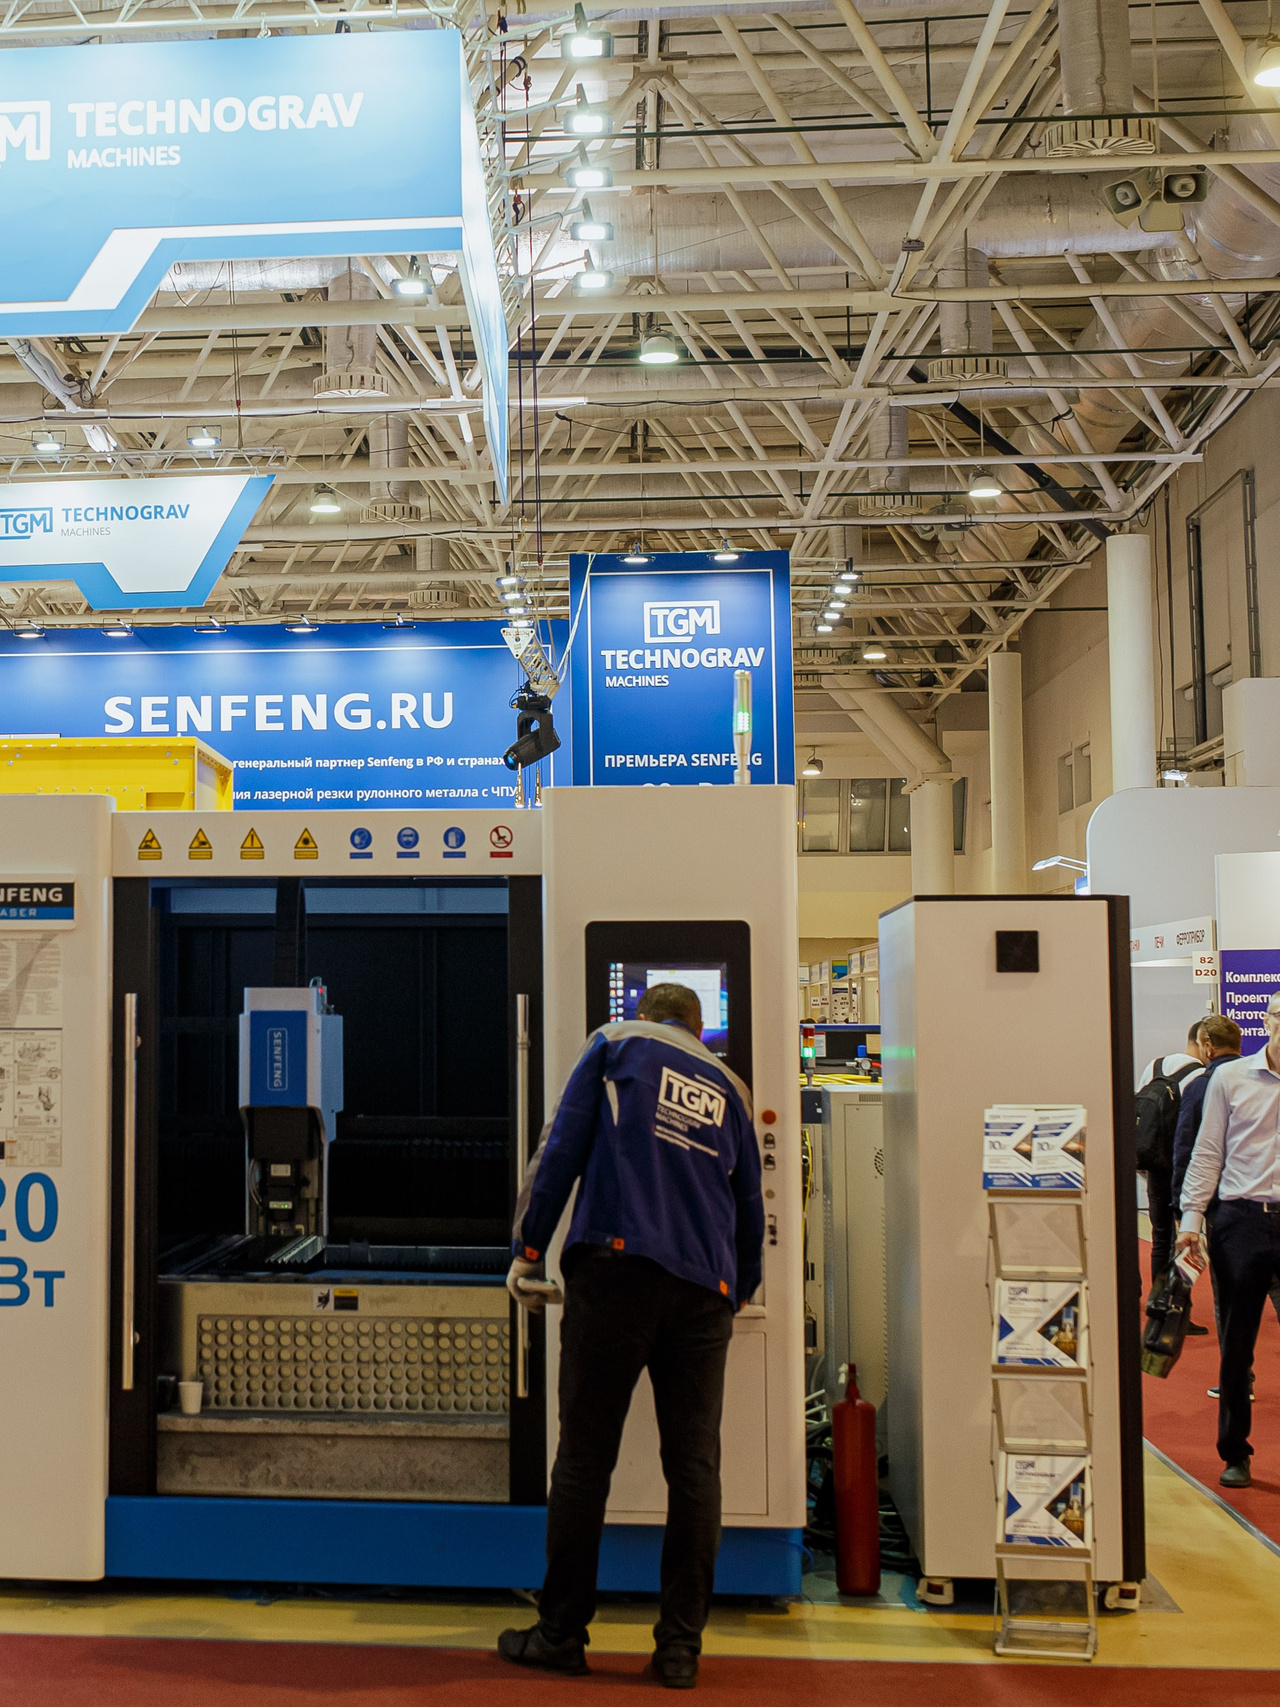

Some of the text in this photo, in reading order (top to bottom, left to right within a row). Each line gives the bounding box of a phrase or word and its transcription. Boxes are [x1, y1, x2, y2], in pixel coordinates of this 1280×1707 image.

[68, 92, 364, 138] TECHNOGRAV
[67, 146, 181, 169] MACHINES
[62, 504, 190, 522] TECHNOGRAV
[61, 526, 111, 538] MACHINES
[649, 605, 718, 638] TGM
[601, 647, 764, 669] TECHNOGRAV
[606, 675, 669, 688] MACHINES
[104, 692, 455, 734] SENFENG.RU
[233, 757, 313, 771] генеральный
[315, 758, 365, 770] партнер
[367, 756, 414, 769] Senfeng
[426, 756, 444, 766] РФ
[446, 758, 455, 766] и
[457, 757, 505, 769] странах
[604, 753, 763, 768] ПРЕМЬЕРА SENFEG
[253, 788, 313, 802] лазерной
[316, 790, 353, 802] резки
[356, 788, 423, 802] рулонного
[425, 787, 479, 799] металла
[481, 788, 489, 798] с
[1199, 956, 1214, 964] 82
[1195, 969, 1217, 977] D20
[273, 1031, 282, 1088] SENFENG
[665, 1073, 723, 1121] TGM
